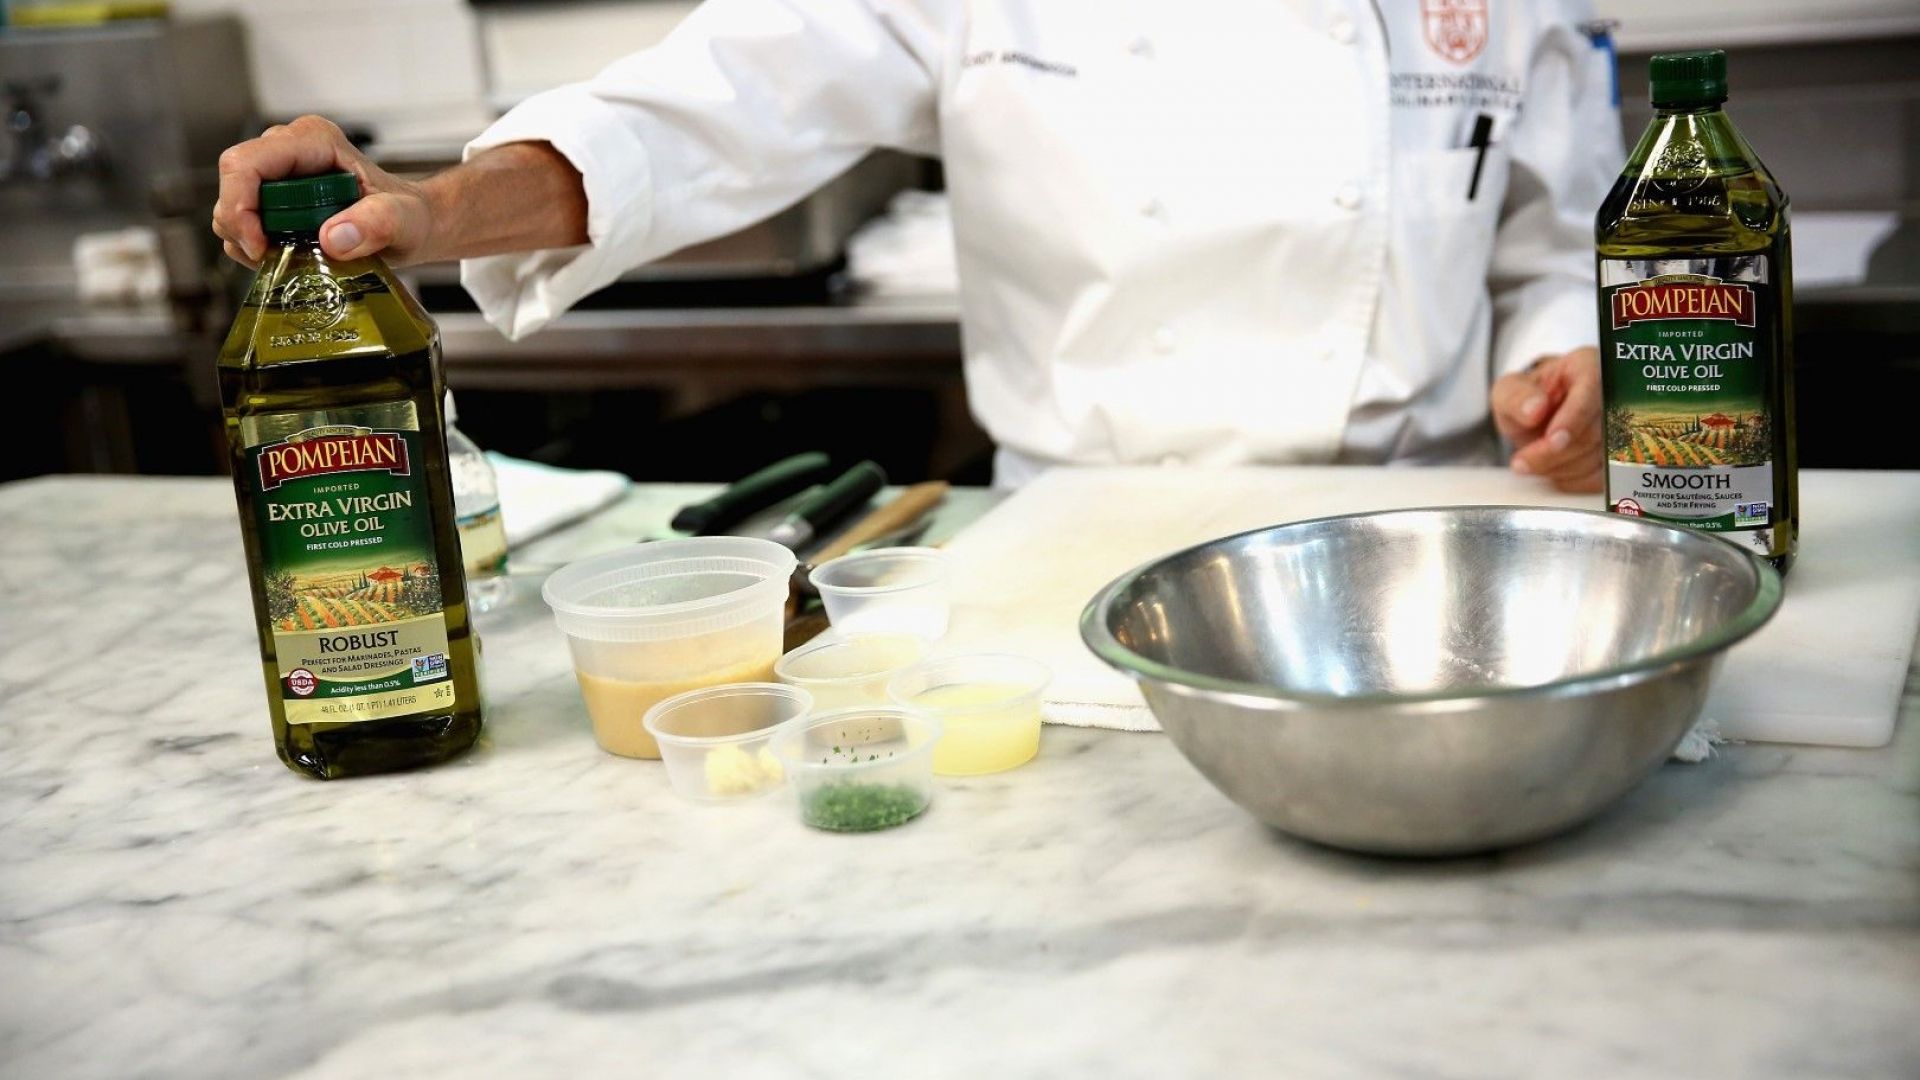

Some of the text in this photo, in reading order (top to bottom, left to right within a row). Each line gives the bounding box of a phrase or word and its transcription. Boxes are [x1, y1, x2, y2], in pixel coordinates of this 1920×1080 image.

[1619, 288, 1743, 318] POMPEIAN
[1616, 341, 1753, 361] EXTRA VIRGIN
[1642, 364, 1723, 379] OLIVE OIL
[1646, 384, 1721, 392] FIRST COLD PRESSED
[268, 438, 398, 478] POMPEIAN
[313, 483, 360, 494] IMPORTED
[1641, 472, 1731, 490] SMOOTH
[1633, 490, 1661, 500] PERFECT
[1661, 492, 1675, 500] FOR
[1714, 492, 1743, 500] SAUCES
[267, 490, 413, 522] EXTRA VIRGIN
[1673, 501, 1688, 509] STIR
[1689, 501, 1717, 509] FRYING
[300, 517, 385, 538] OLIVE OIL
[1689, 521, 1705, 529] than
[306, 536, 383, 551] FIRST COLD PRESSED
[319, 630, 399, 653] ROBUST
[301, 657, 331, 666] PERFECT
[332, 656, 346, 664] FOR
[393, 647, 422, 657] PASTAS
[321, 658, 404, 673] AND SALAD DRESSINGS
[291, 678, 314, 686] USDA
[330, 685, 354, 695] Acidity
[354, 684, 367, 692] less
[367, 682, 384, 690] than
[396, 695, 417, 706] LITERS
